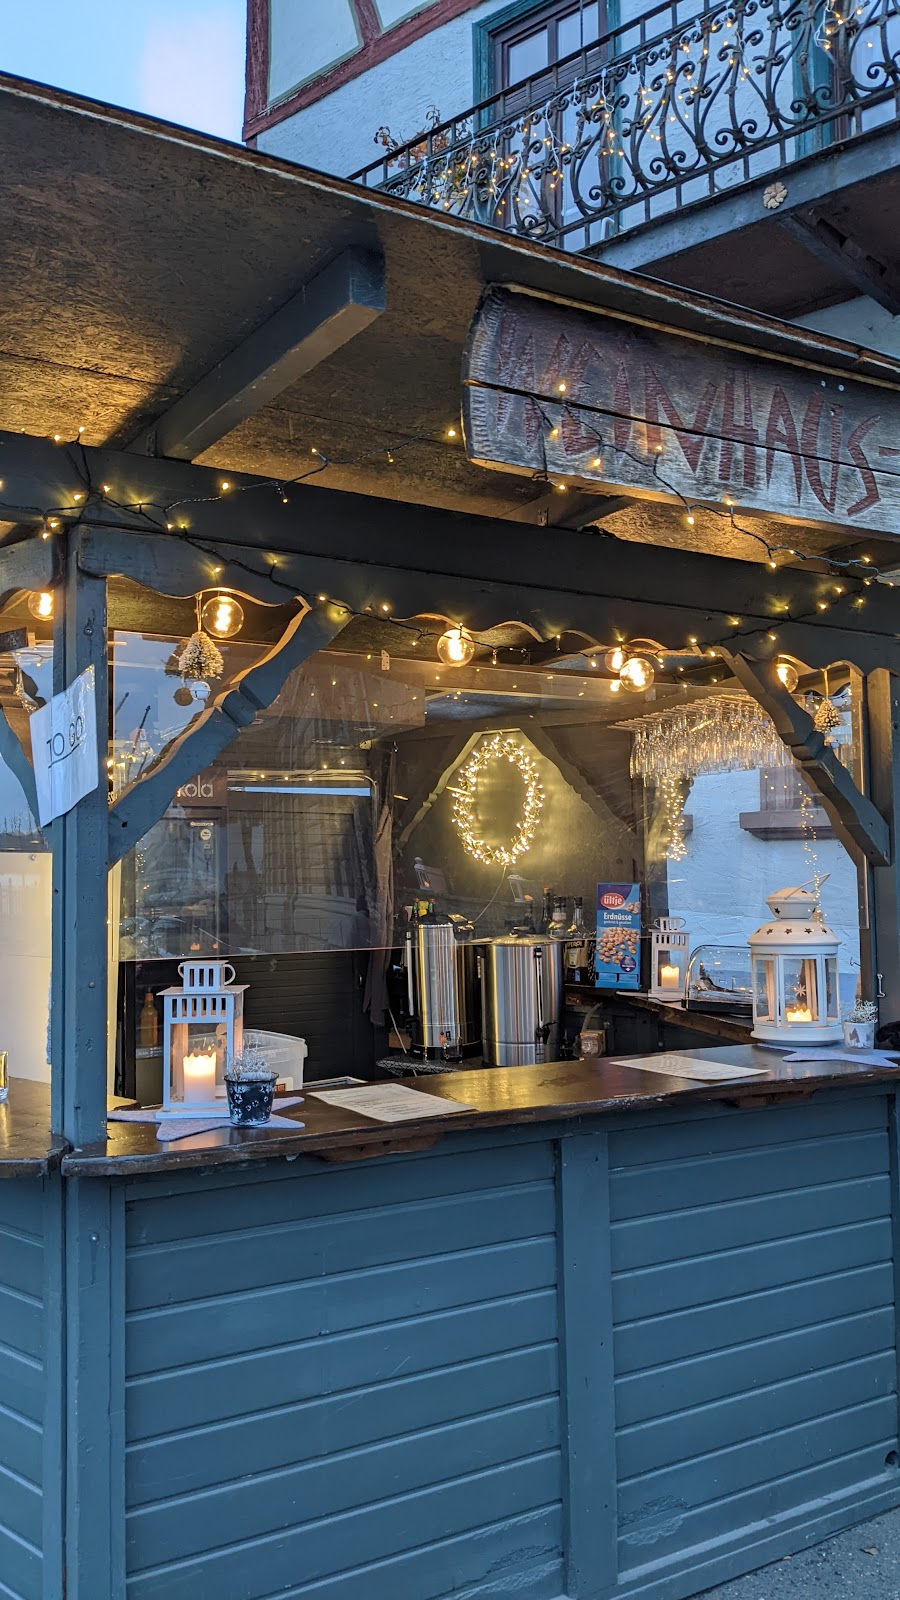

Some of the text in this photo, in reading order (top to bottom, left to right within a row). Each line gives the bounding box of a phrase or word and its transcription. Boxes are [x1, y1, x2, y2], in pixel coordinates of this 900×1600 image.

[46, 715, 83, 762] TO GO
[603, 895, 623, 906] ültje
[603, 912, 632, 921] Erdnüsse
